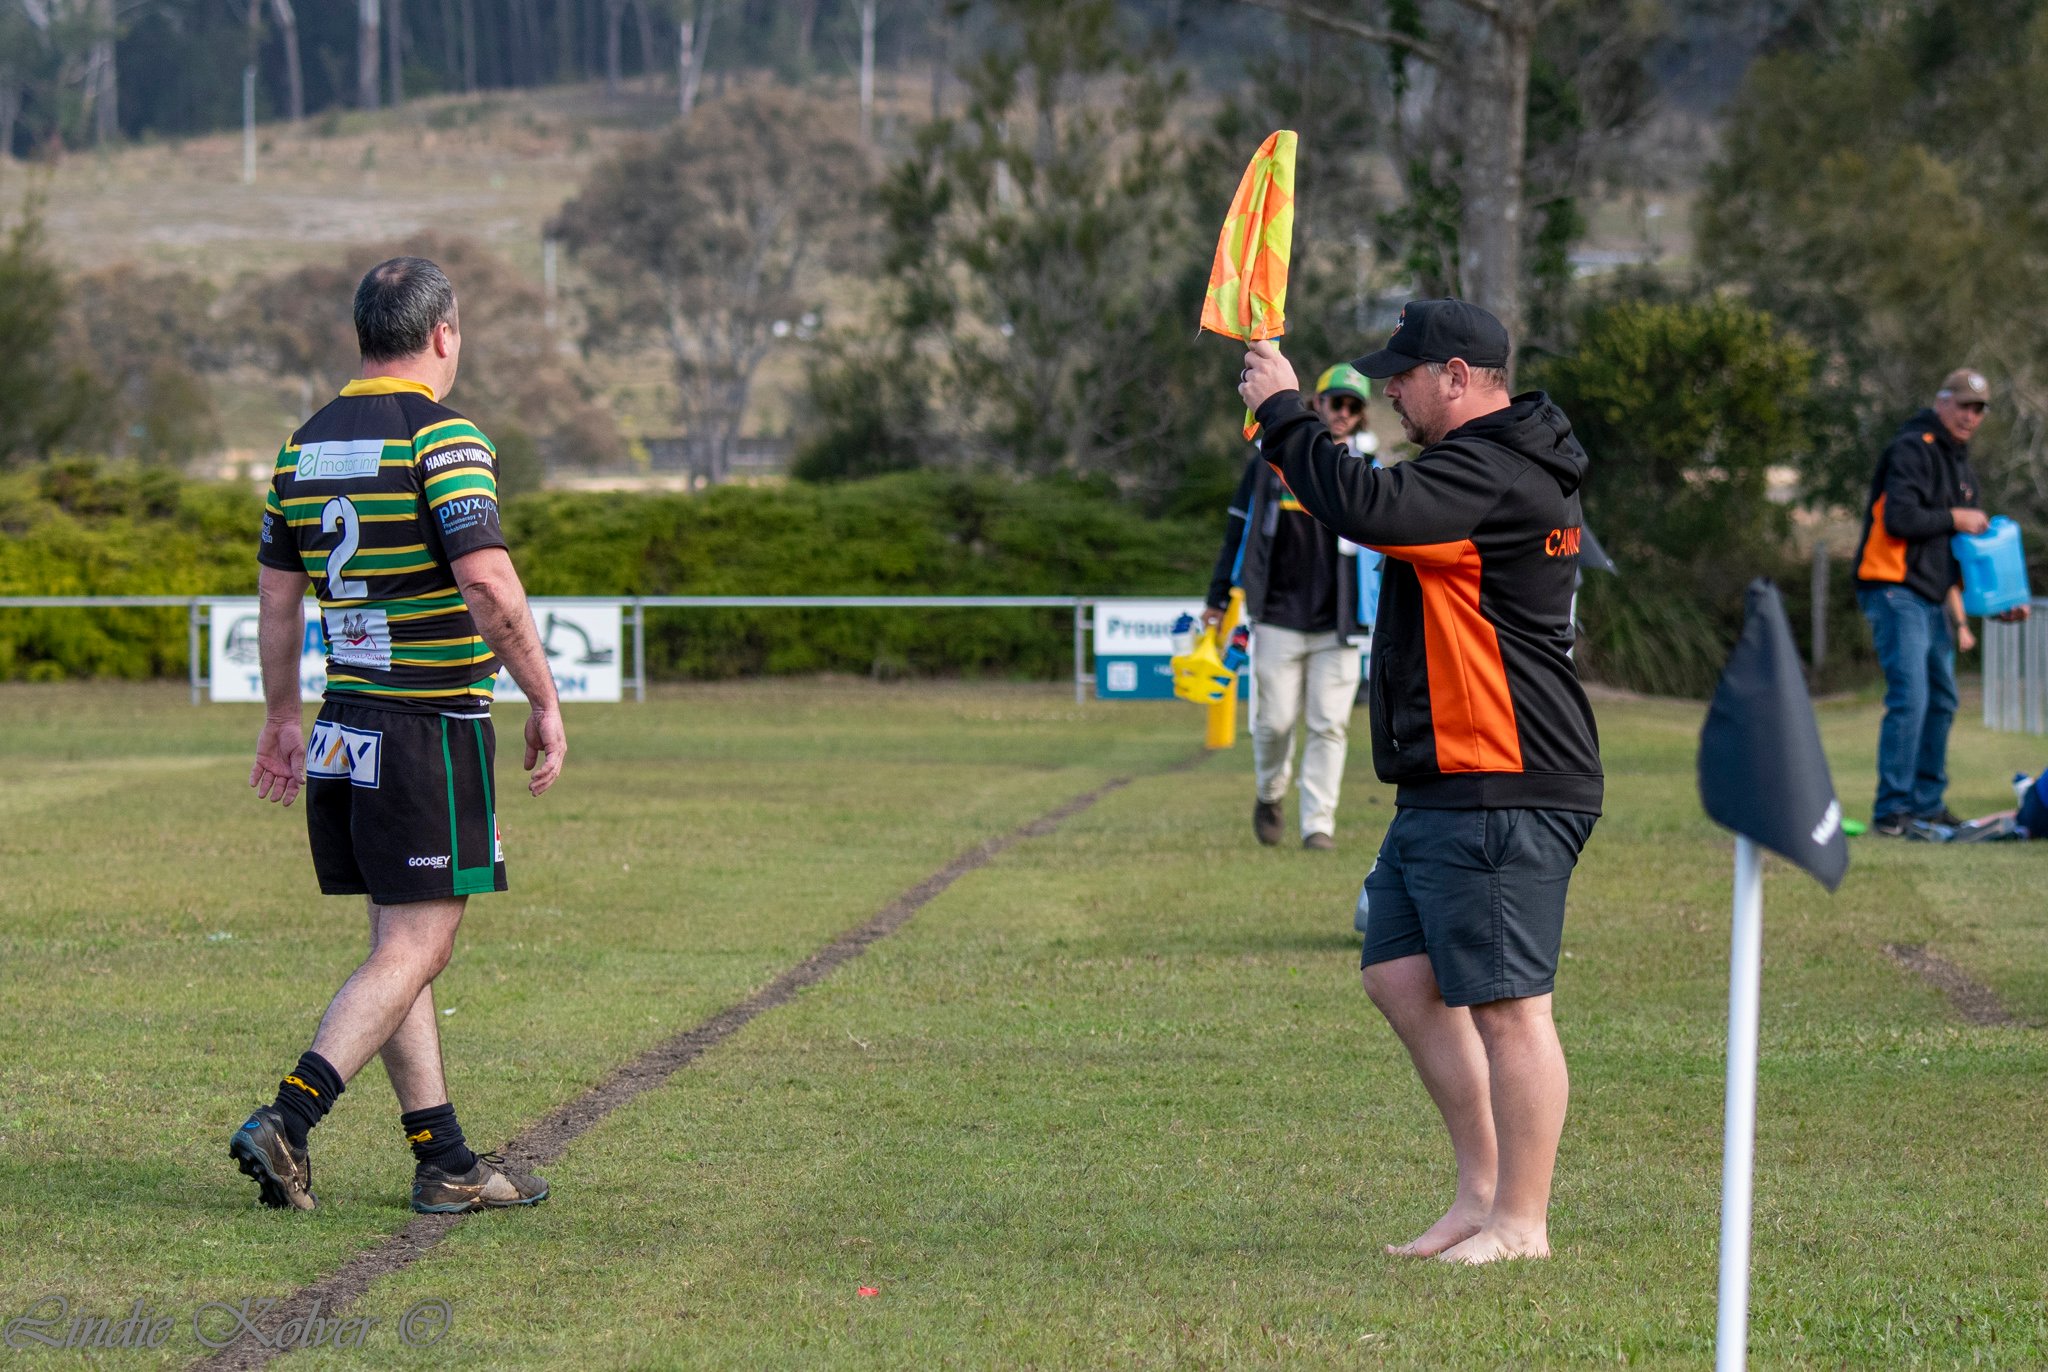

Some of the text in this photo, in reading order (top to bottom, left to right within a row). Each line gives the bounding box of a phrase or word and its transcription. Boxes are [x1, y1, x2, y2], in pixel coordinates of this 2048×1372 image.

[320, 459, 358, 473] motor
[360, 455, 378, 471] inn
[321, 495, 368, 599] 2
[408, 855, 451, 867] GOOSEY
